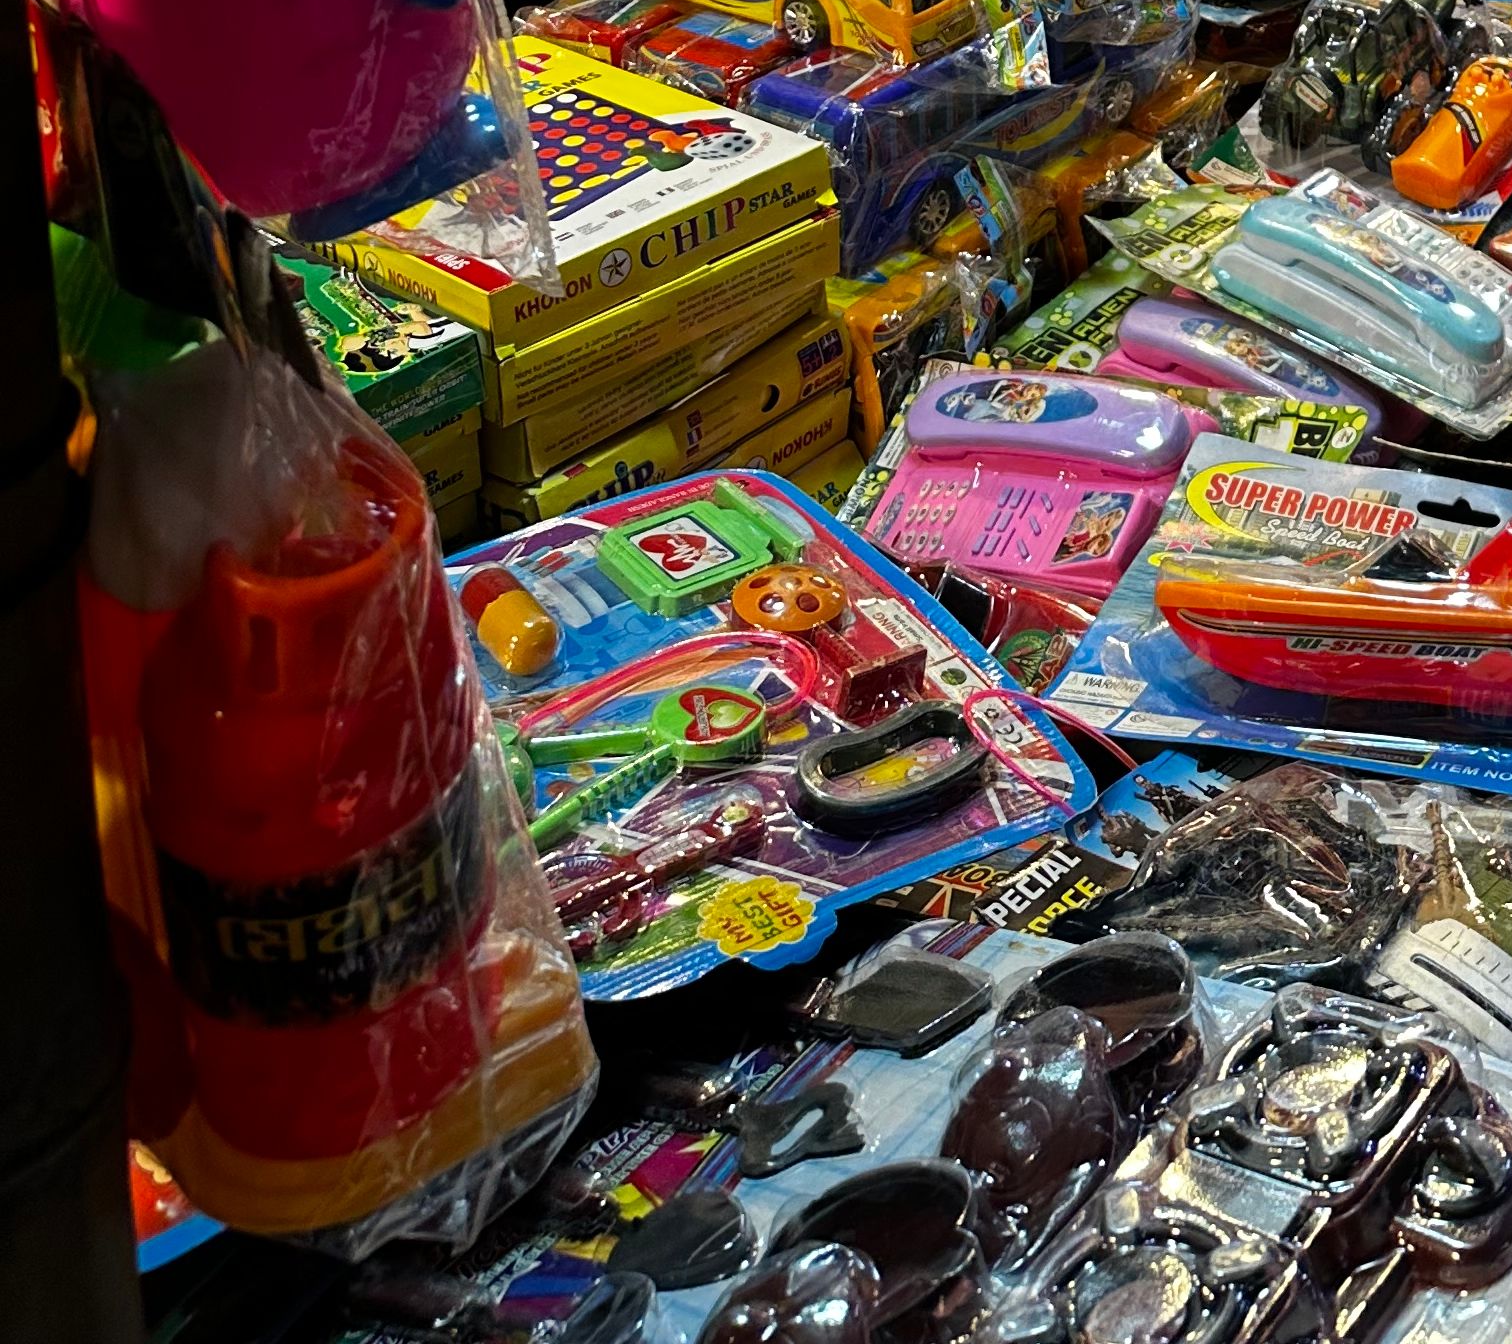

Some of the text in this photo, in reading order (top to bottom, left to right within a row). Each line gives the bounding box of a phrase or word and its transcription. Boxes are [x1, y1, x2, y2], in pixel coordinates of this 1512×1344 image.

[538, 71, 602, 99] GAMES
[783, 185, 818, 210] GAMES
[640, 196, 746, 269] CHIP
[748, 182, 794, 212] STAR
[388, 268, 438, 305] KHOKON
[1073, 290, 1140, 335] ALIEN
[772, 418, 833, 465] KHOKON
[1205, 472, 1418, 538] SUPER POWER
[1260, 518, 1370, 551] Speed Boat
[872, 611, 908, 644] RNING
[1289, 635, 1488, 660] HI-SPEED BOAT
[1430, 761, 1479, 777] ITEM
[984, 848, 1082, 928] PECIAL
[1020, 875, 1102, 936] ORCE
[732, 896, 784, 941] BEST
[757, 889, 803, 929] GIFT
[717, 914, 754, 945] MY
